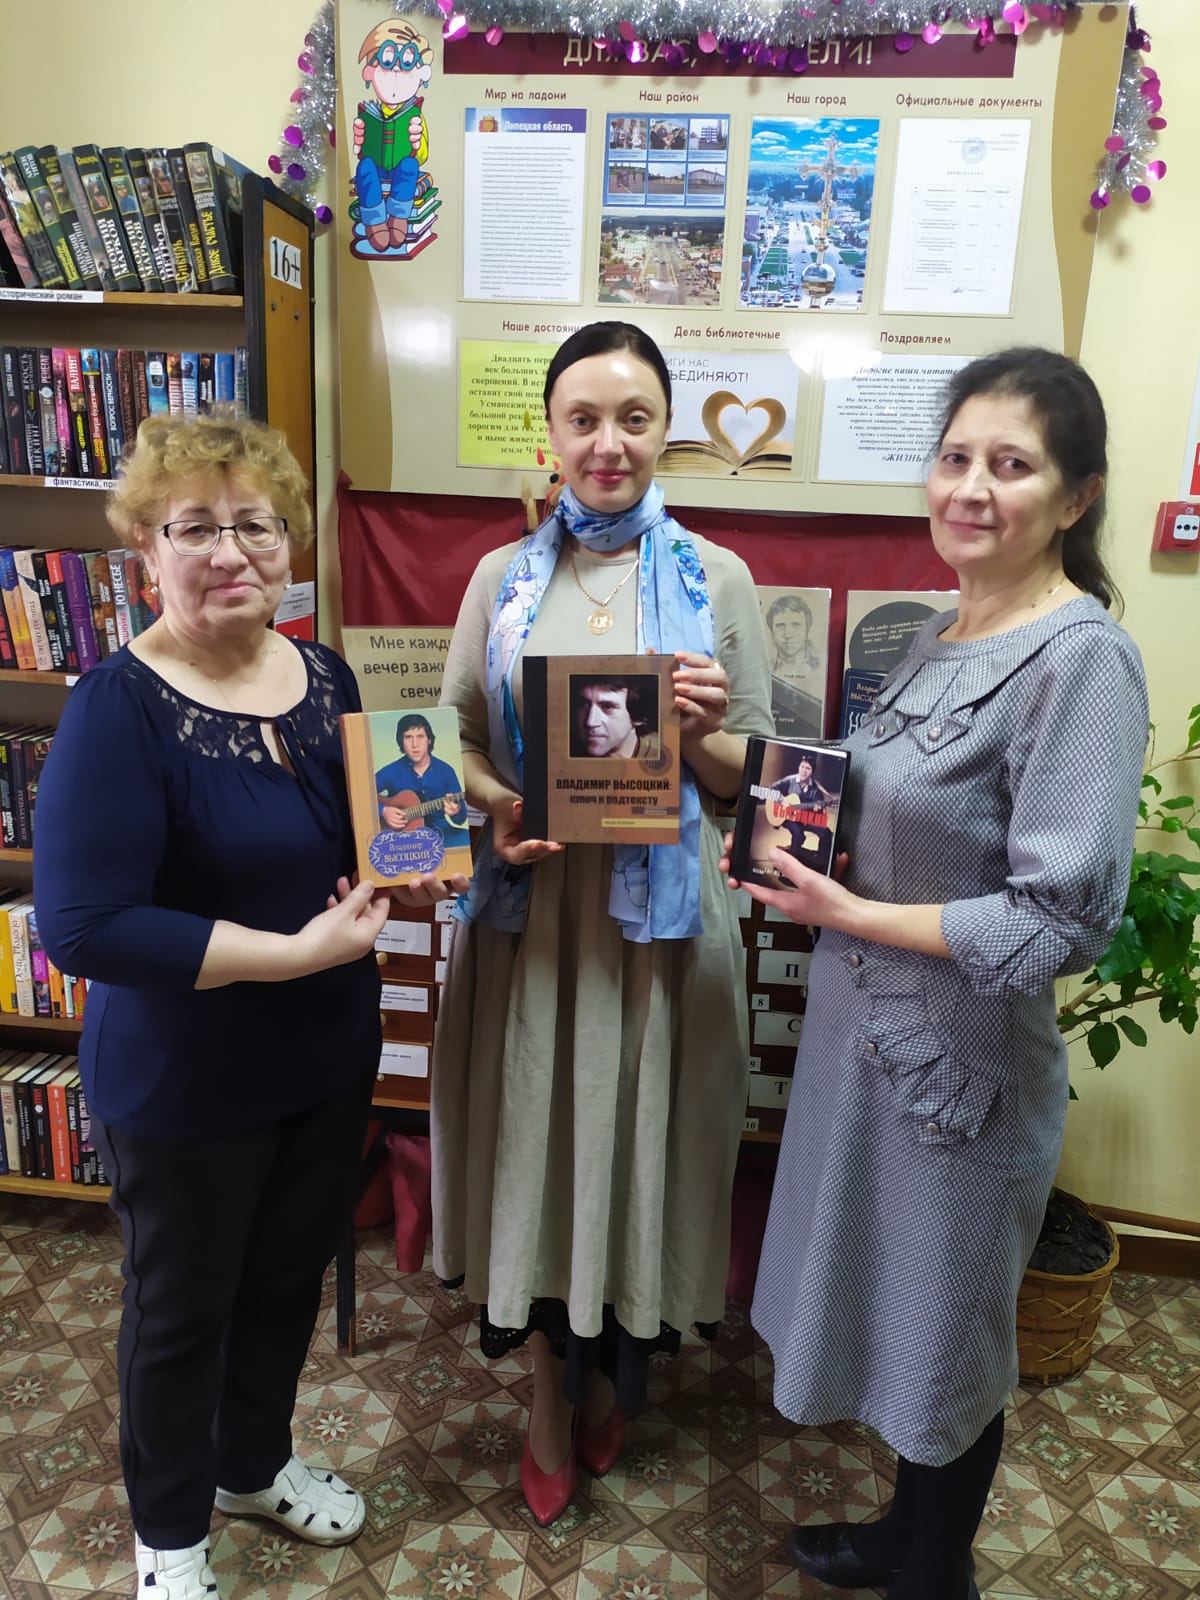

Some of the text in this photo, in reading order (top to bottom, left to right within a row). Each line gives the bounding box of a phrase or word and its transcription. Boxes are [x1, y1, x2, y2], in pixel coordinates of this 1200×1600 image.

[485, 88, 567, 104] Мир на ладони
[639, 90, 699, 104] Наш район
[787, 92, 847, 106] Наш город
[896, 93, 1042, 109] Официальные документы
[543, 121, 574, 132] область
[97, 218, 120, 277] ГЕОРГИЙ
[107, 219, 129, 274] МАРКОВ
[135, 222, 154, 276] МАРКОВ
[272, 239, 300, 282] 16+
[502, 320, 530, 332] Наше
[674, 325, 781, 340] Дела библиотечные
[881, 331, 951, 345] Поздравляем
[484, 366, 499, 374] век
[689, 359, 709, 368] НАС
[894, 367, 919, 375] наши
[504, 390, 523, 398] свой
[53, 478, 101, 489] фантастика,
[111, 564, 124, 593] НЕСБЕ
[116, 595, 126, 605] Ю
[370, 635, 405, 649] Мне
[363, 662, 409, 677] вечер
[556, 778, 672, 792] ВЛАДИМИР ВЫСОЦКИЙ:
[384, 850, 431, 862] ВЫСОЦКИЙ
[762, 935, 769, 945] 7
[784, 963, 801, 979] П
[757, 998, 764, 1007] 8
[787, 1018, 801, 1034] С
[750, 1060, 757, 1069] 9
[774, 1081, 789, 1097] Т
[746, 1121, 757, 1131] 10
